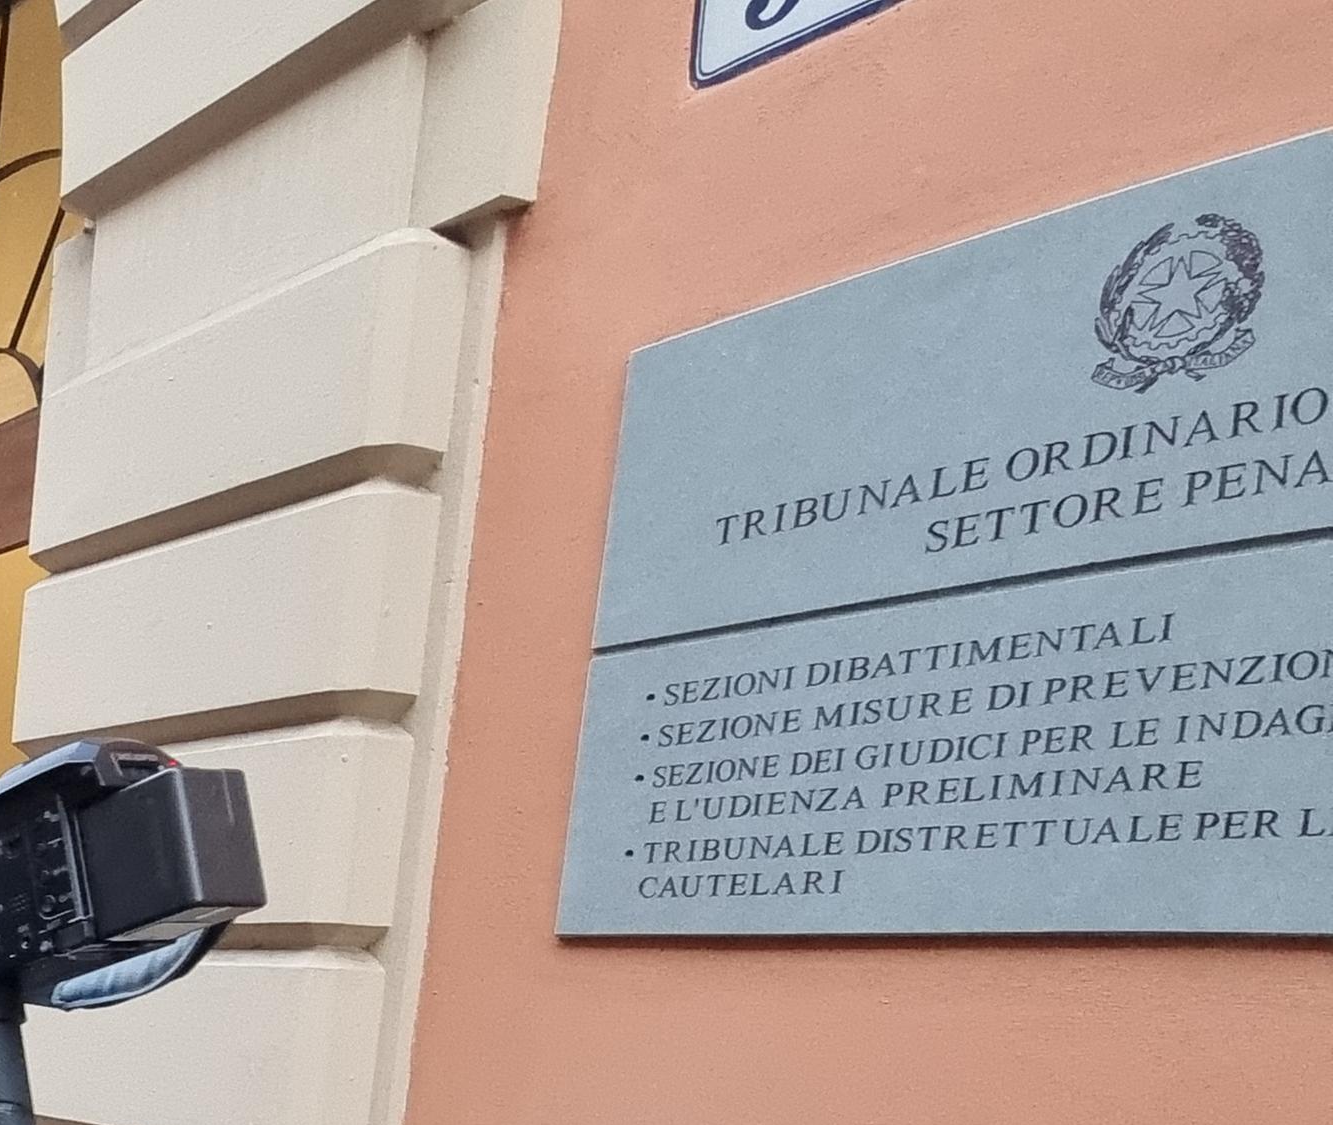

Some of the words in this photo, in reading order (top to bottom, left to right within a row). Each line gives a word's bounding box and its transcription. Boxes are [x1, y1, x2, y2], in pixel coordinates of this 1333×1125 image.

[716, 456, 991, 546] TRIBUNALE
[1005, 387, 1329, 482] ORDINARIO
[925, 477, 1165, 554] SETTORE
[663, 665, 797, 707] SEZIONI
[805, 611, 1175, 688] DIBATTIMENTALI
[657, 708, 802, 747] SEZIONE
[813, 686, 975, 731] MISURE
[986, 680, 1034, 711] DI
[651, 754, 781, 788] SEZIONE
[789, 747, 847, 776] DEI
[854, 731, 1008, 771] GIUDICI
[1019, 724, 1095, 757] PER
[1108, 717, 1160, 749] LE
[648, 801, 667, 825] E
[673, 784, 868, 821] L'UDIENZA
[880, 760, 1204, 809] PRELIMINARE
[642, 831, 845, 864] TRIBUNALE
[854, 813, 1184, 855] DISTRETTUALE
[1192, 809, 1282, 841] PER
[1297, 808, 1333, 838] L
[637, 869, 846, 898] CAUTELARI
